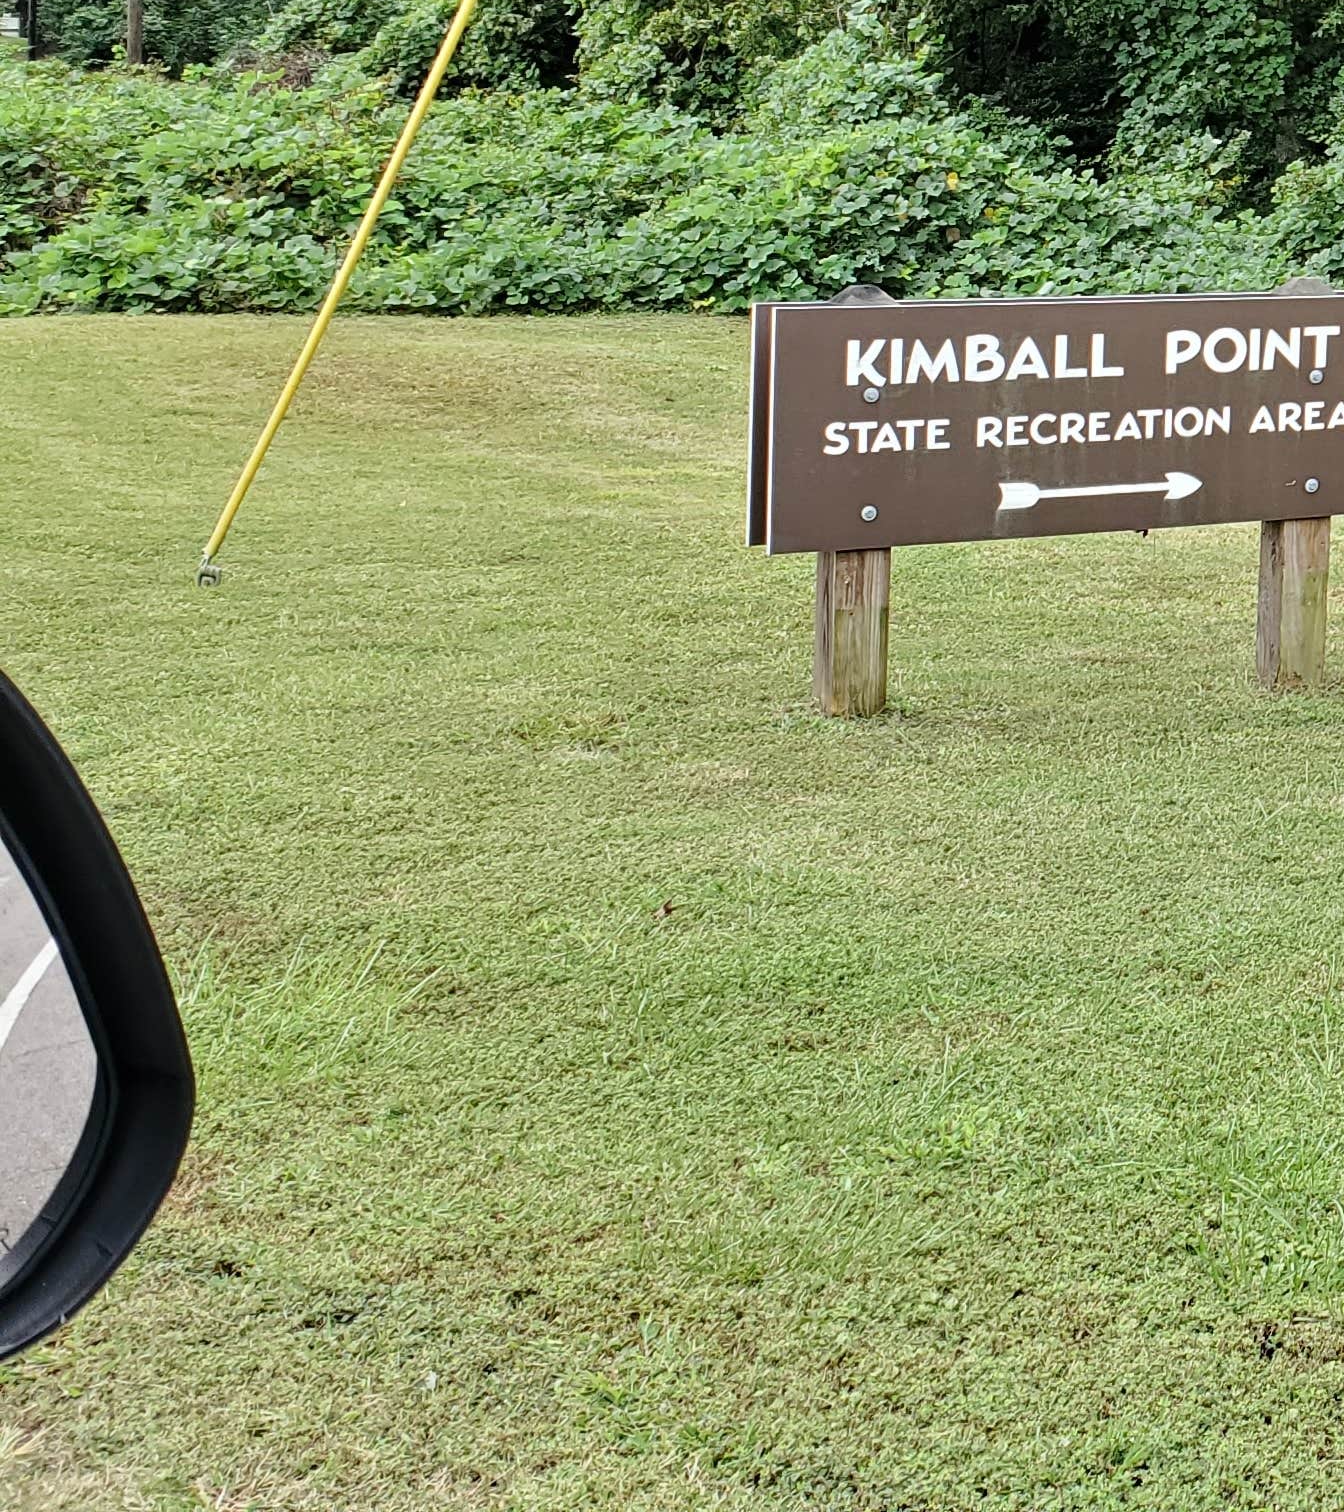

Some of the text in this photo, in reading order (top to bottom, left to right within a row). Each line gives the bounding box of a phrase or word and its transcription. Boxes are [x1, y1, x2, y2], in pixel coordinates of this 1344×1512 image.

[846, 325, 1342, 388] KIMBALL POINT
[823, 418, 951, 456] STATE
[976, 405, 1231, 448] RECREATION
